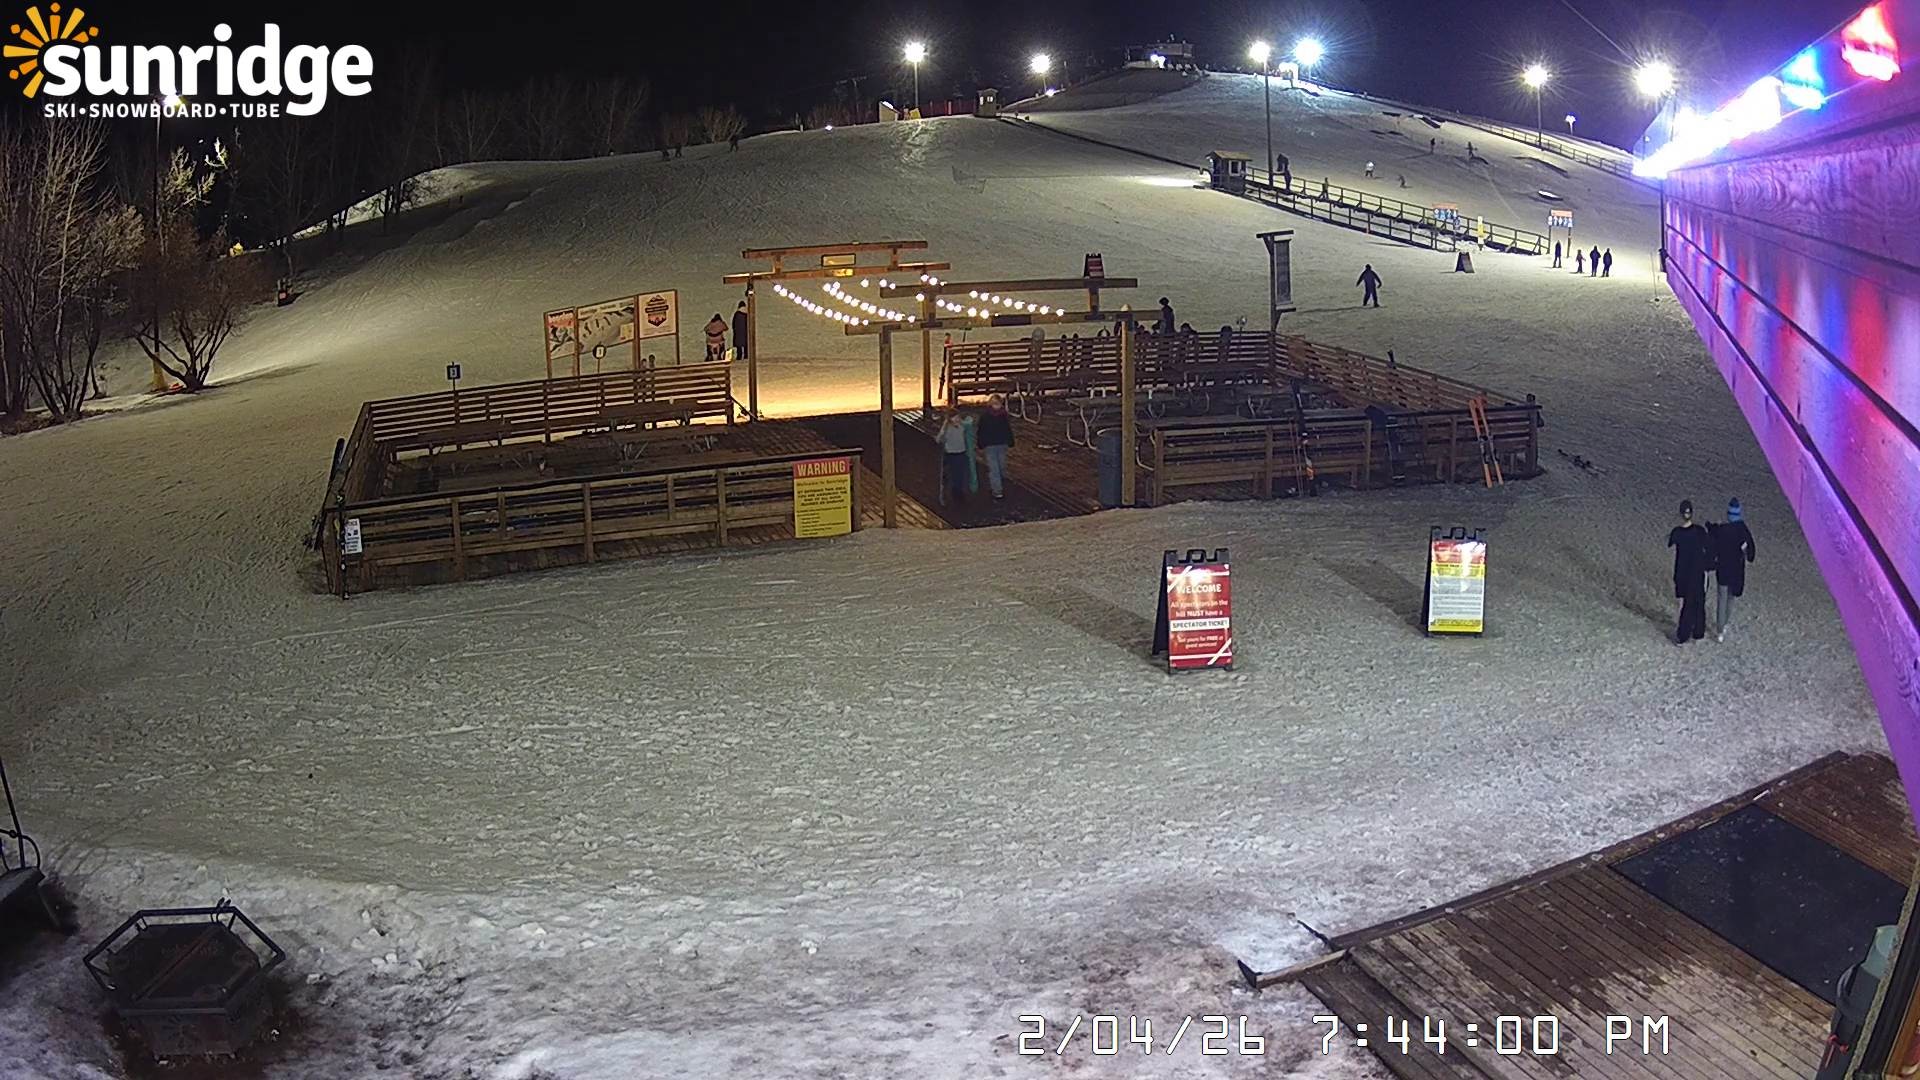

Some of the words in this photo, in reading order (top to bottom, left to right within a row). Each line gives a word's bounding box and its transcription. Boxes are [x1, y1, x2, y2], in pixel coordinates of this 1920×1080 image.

[797, 461, 846, 477] WARNING
[1176, 583, 1222, 594] WELCOME
[1172, 621, 1207, 629] SPECTATOR
